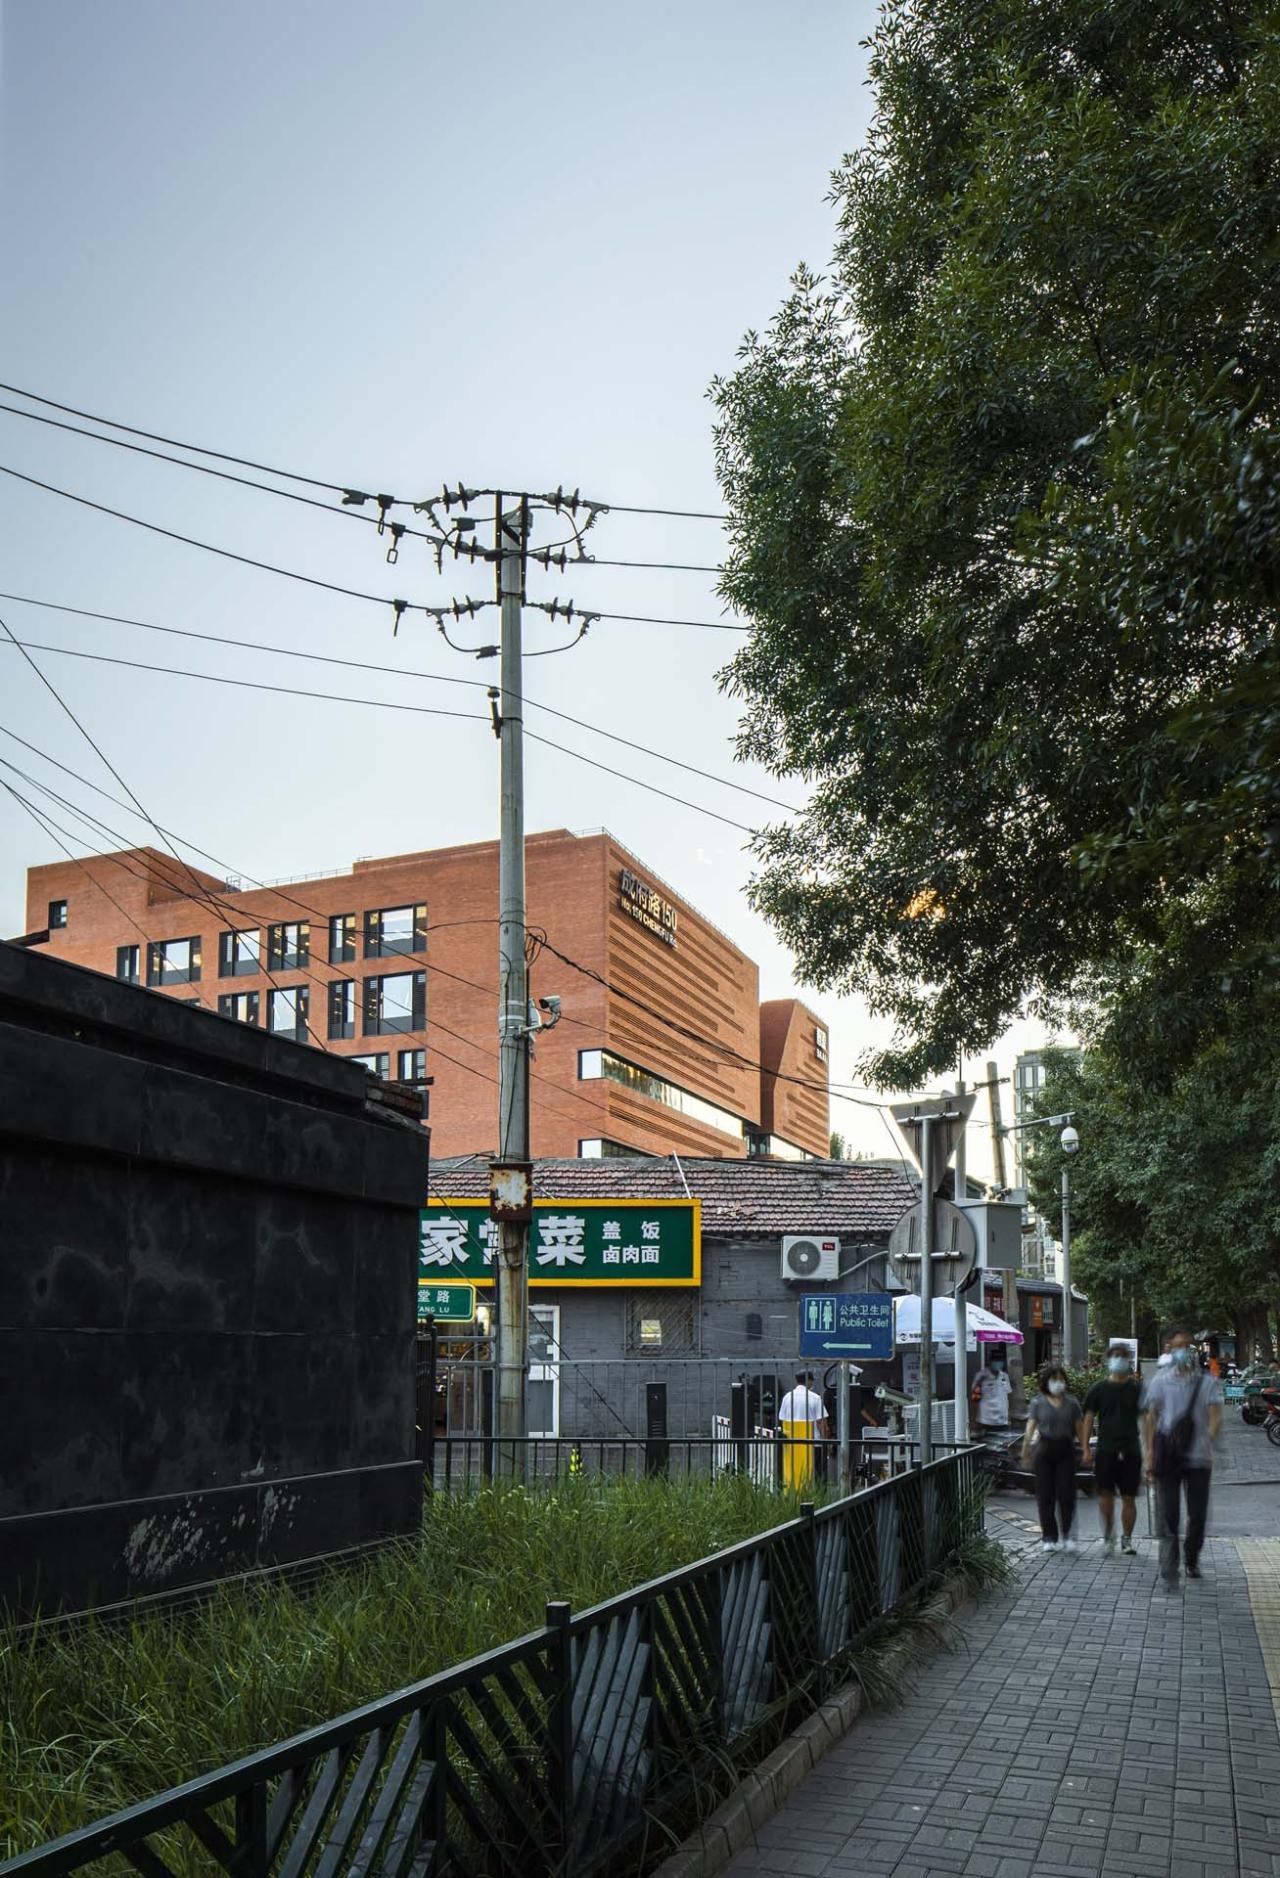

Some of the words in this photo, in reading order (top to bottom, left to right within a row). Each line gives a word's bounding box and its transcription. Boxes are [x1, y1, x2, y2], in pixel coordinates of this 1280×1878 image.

[602, 1245, 660, 1264] 卤肉面
[839, 1304, 890, 1316] 公共卫生间
[840, 1317, 866, 1328] Public
[867, 1317, 889, 1328] Toilet
